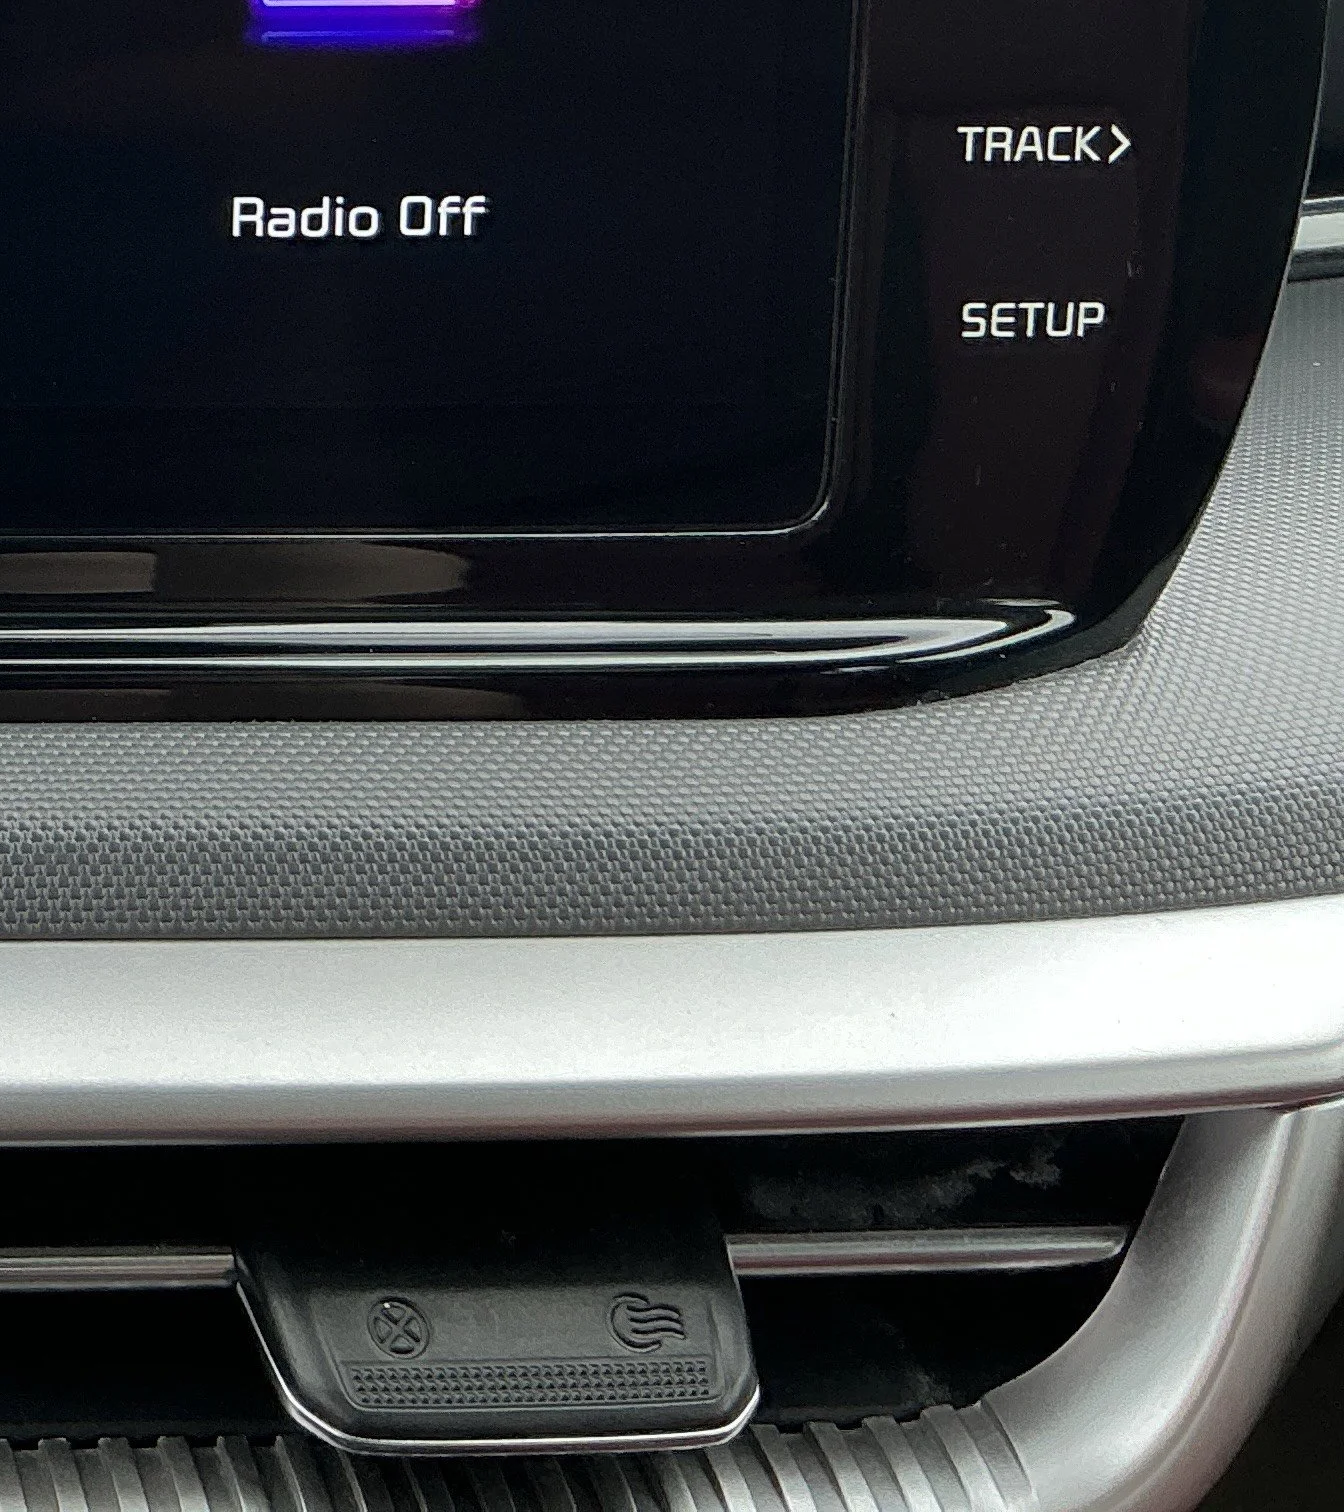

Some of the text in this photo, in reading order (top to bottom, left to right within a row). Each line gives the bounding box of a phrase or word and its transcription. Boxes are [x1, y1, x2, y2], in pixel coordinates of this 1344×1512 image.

[232, 194, 488, 238] Radio Off
[961, 301, 1106, 338] SETUP
